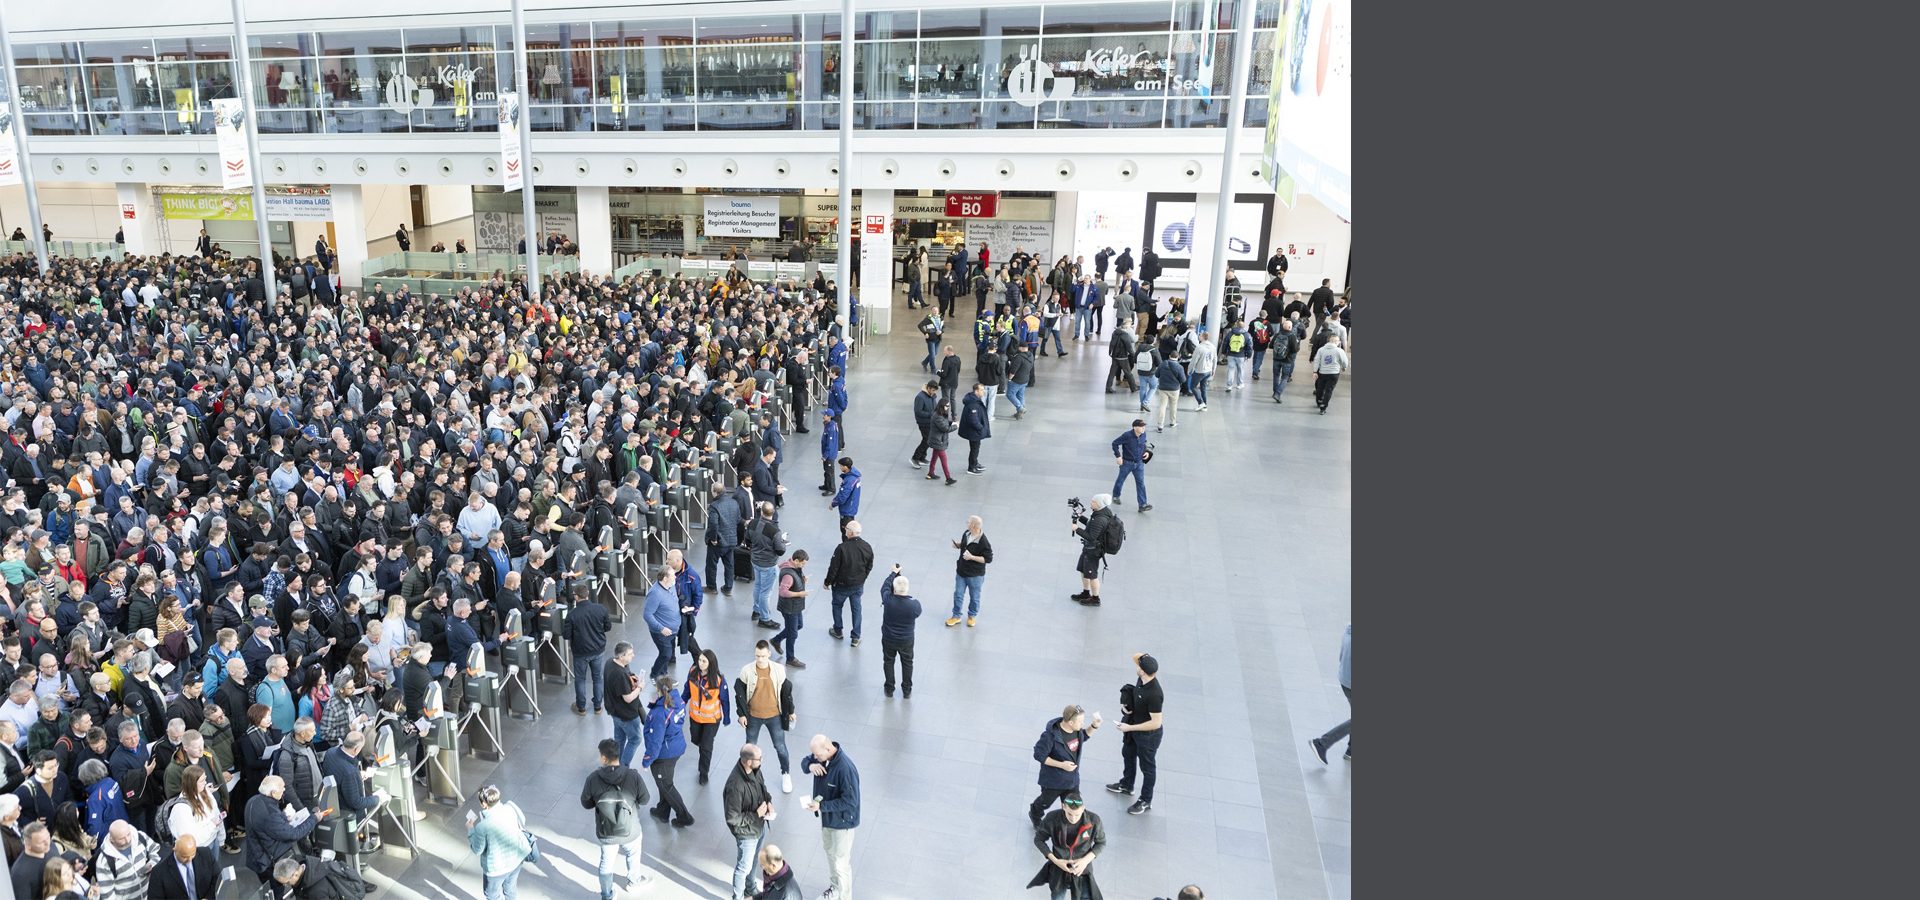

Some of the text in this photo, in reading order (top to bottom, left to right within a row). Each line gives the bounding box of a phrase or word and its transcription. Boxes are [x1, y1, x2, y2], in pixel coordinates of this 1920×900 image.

[1083, 46, 1150, 78] Käfer
[438, 63, 484, 88] Käfer
[1134, 80, 1161, 90] am
[475, 91, 496, 100] am
[20, 97, 37, 108] See
[165, 198, 196, 209] THINK
[197, 199, 218, 210] BIG!
[707, 210, 751, 218] Registrierleitung
